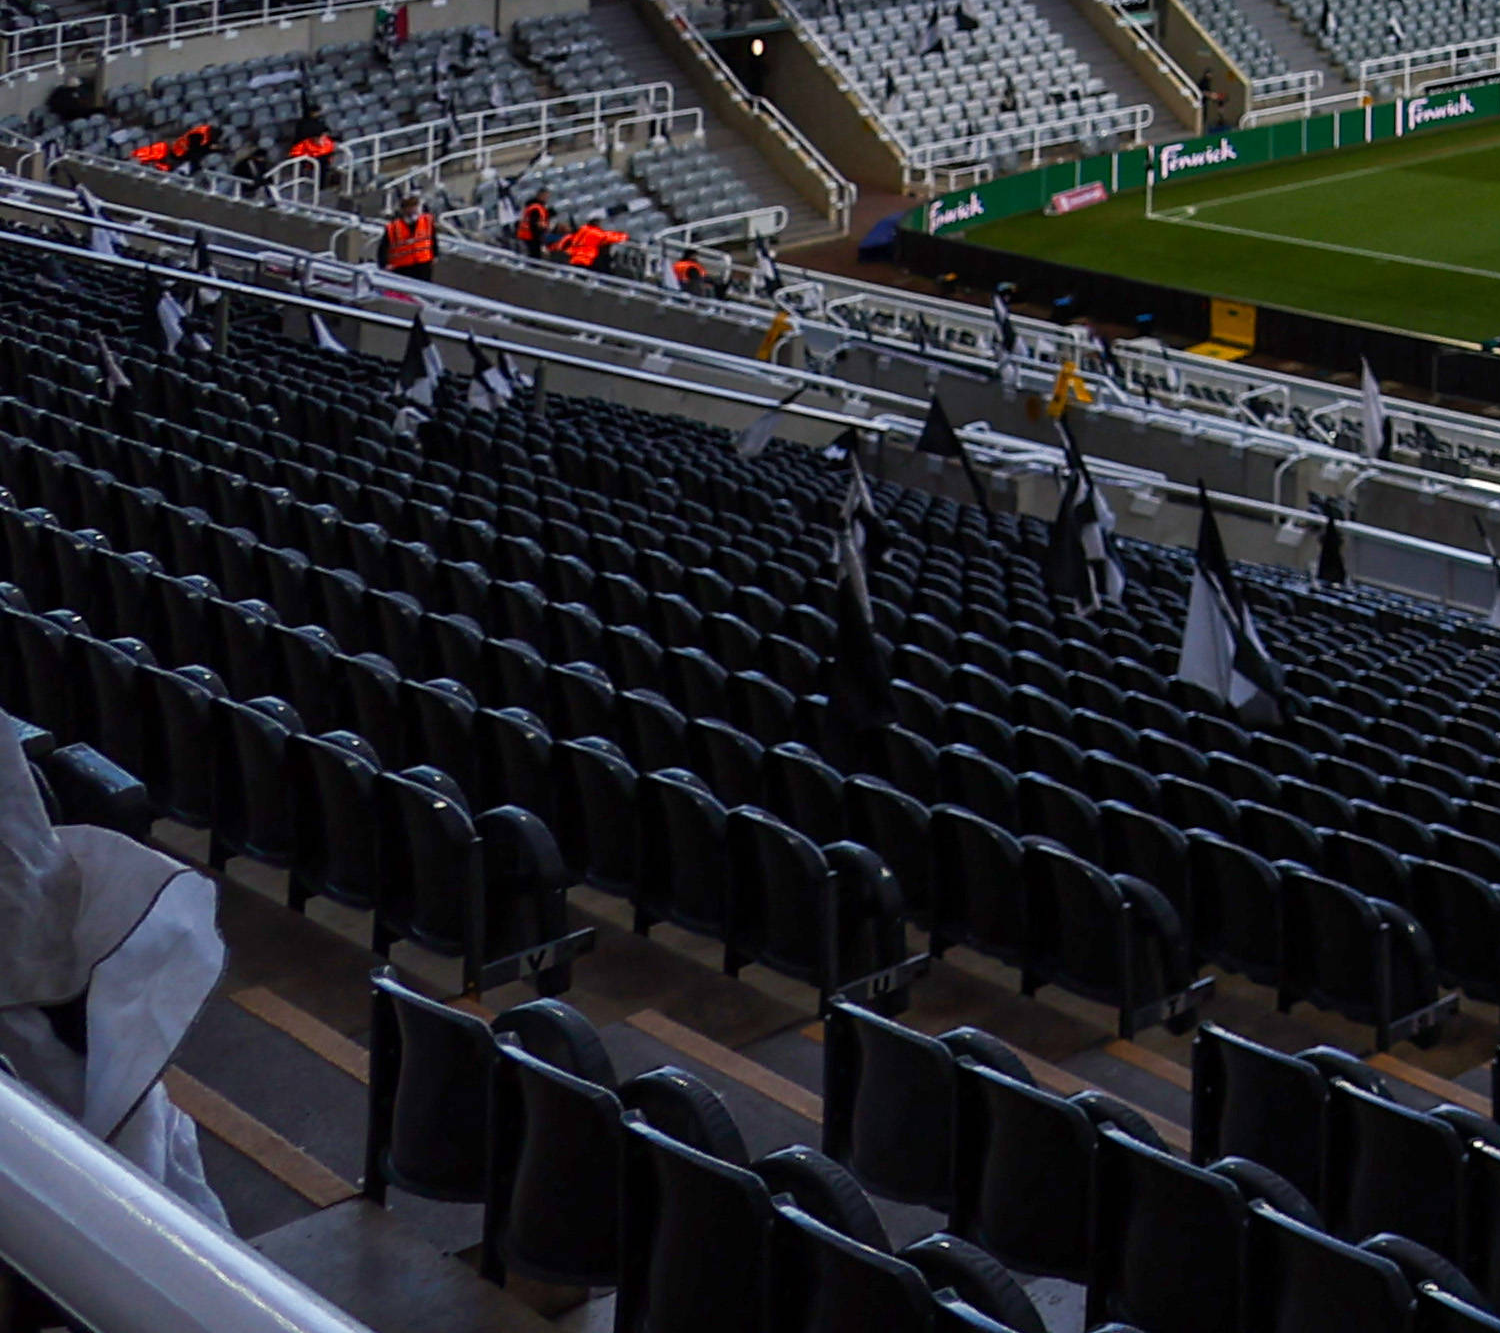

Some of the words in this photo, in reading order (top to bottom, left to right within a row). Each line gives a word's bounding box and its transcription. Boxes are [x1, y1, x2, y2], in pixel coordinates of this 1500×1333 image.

[1407, 93, 1475, 130] Fenwick
[1159, 138, 1238, 180] Fenwick
[928, 192, 985, 235] Fenwick
[527, 949, 546, 971] V
[873, 976, 890, 994] U
